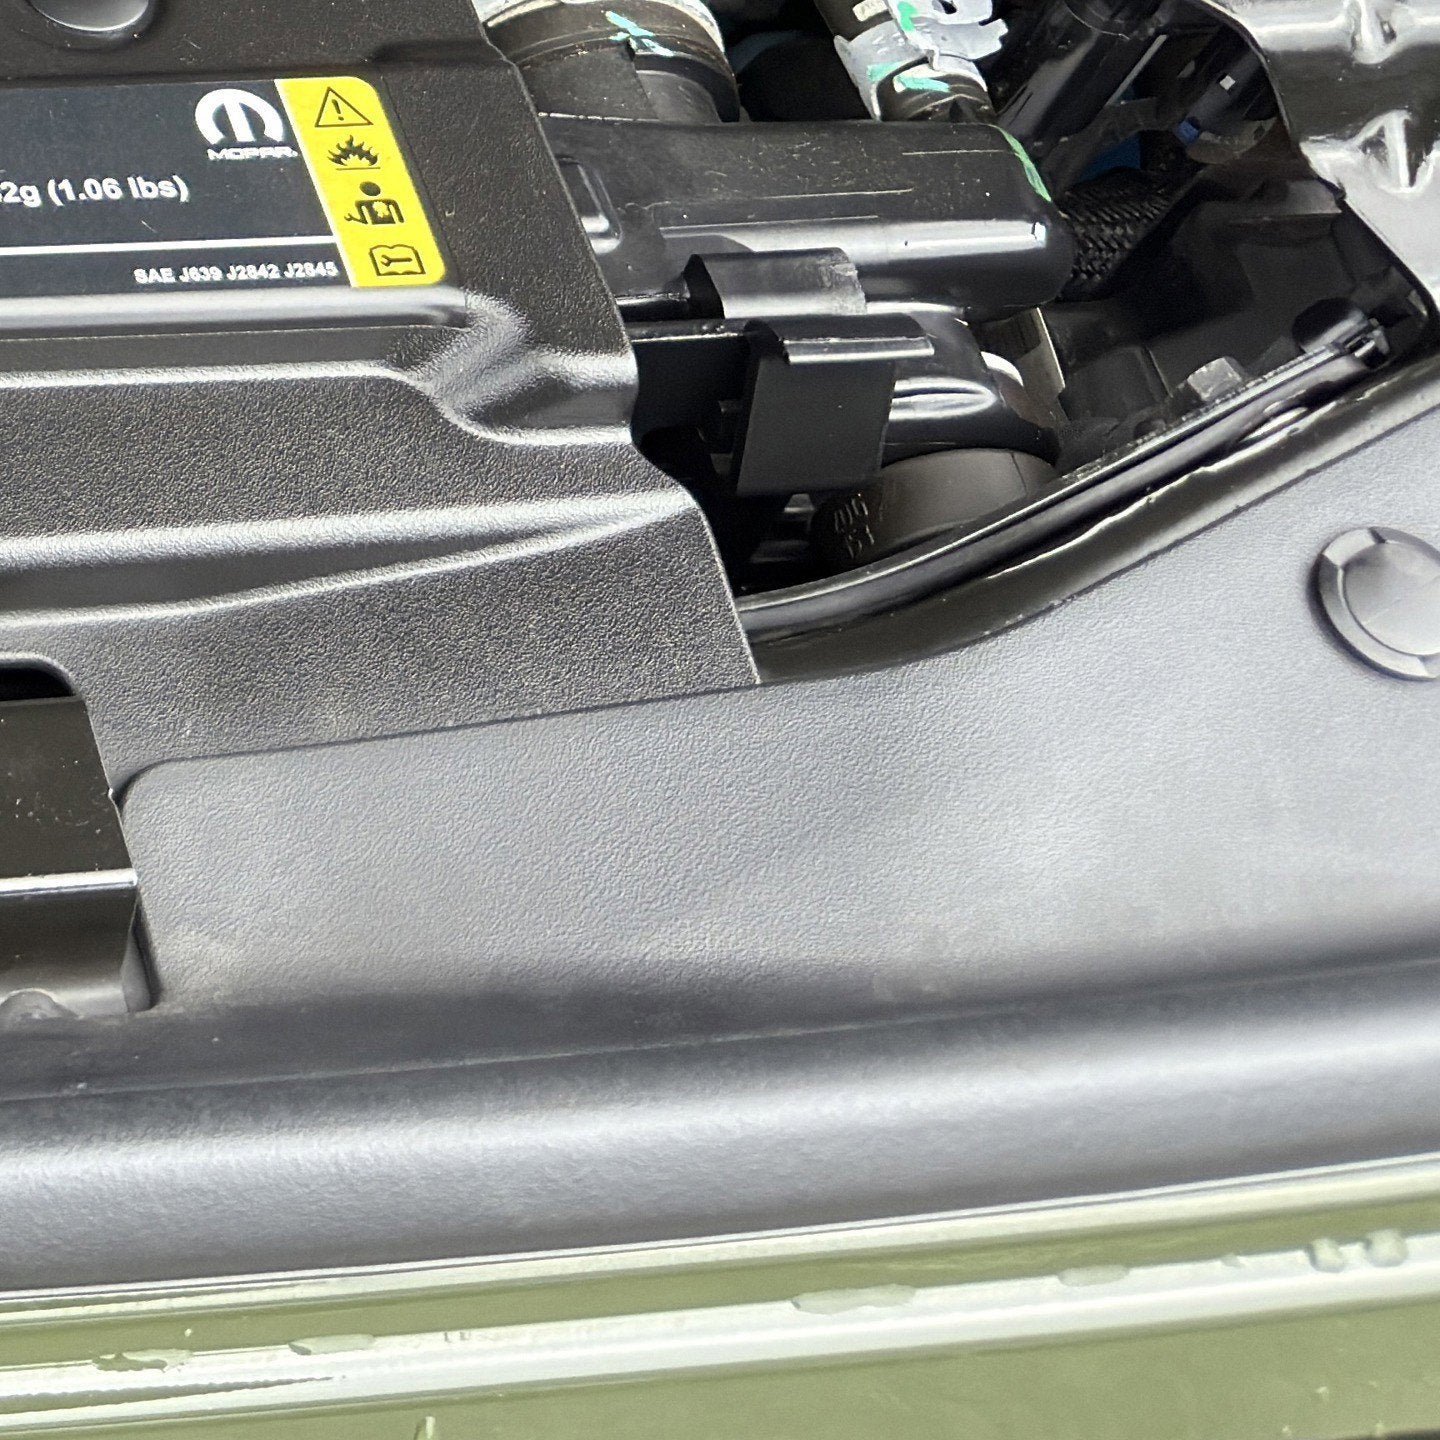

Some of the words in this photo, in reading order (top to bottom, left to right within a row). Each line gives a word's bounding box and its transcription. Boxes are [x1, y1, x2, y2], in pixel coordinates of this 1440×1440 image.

[207, 146, 294, 160] MOPAR
[49, 177, 122, 207] (1.06
[130, 174, 190, 203] lbs)
[133, 267, 176, 285] SAE
[179, 265, 223, 283] J639
[226, 263, 281, 281] J2842
[283, 261, 340, 279] J2845
